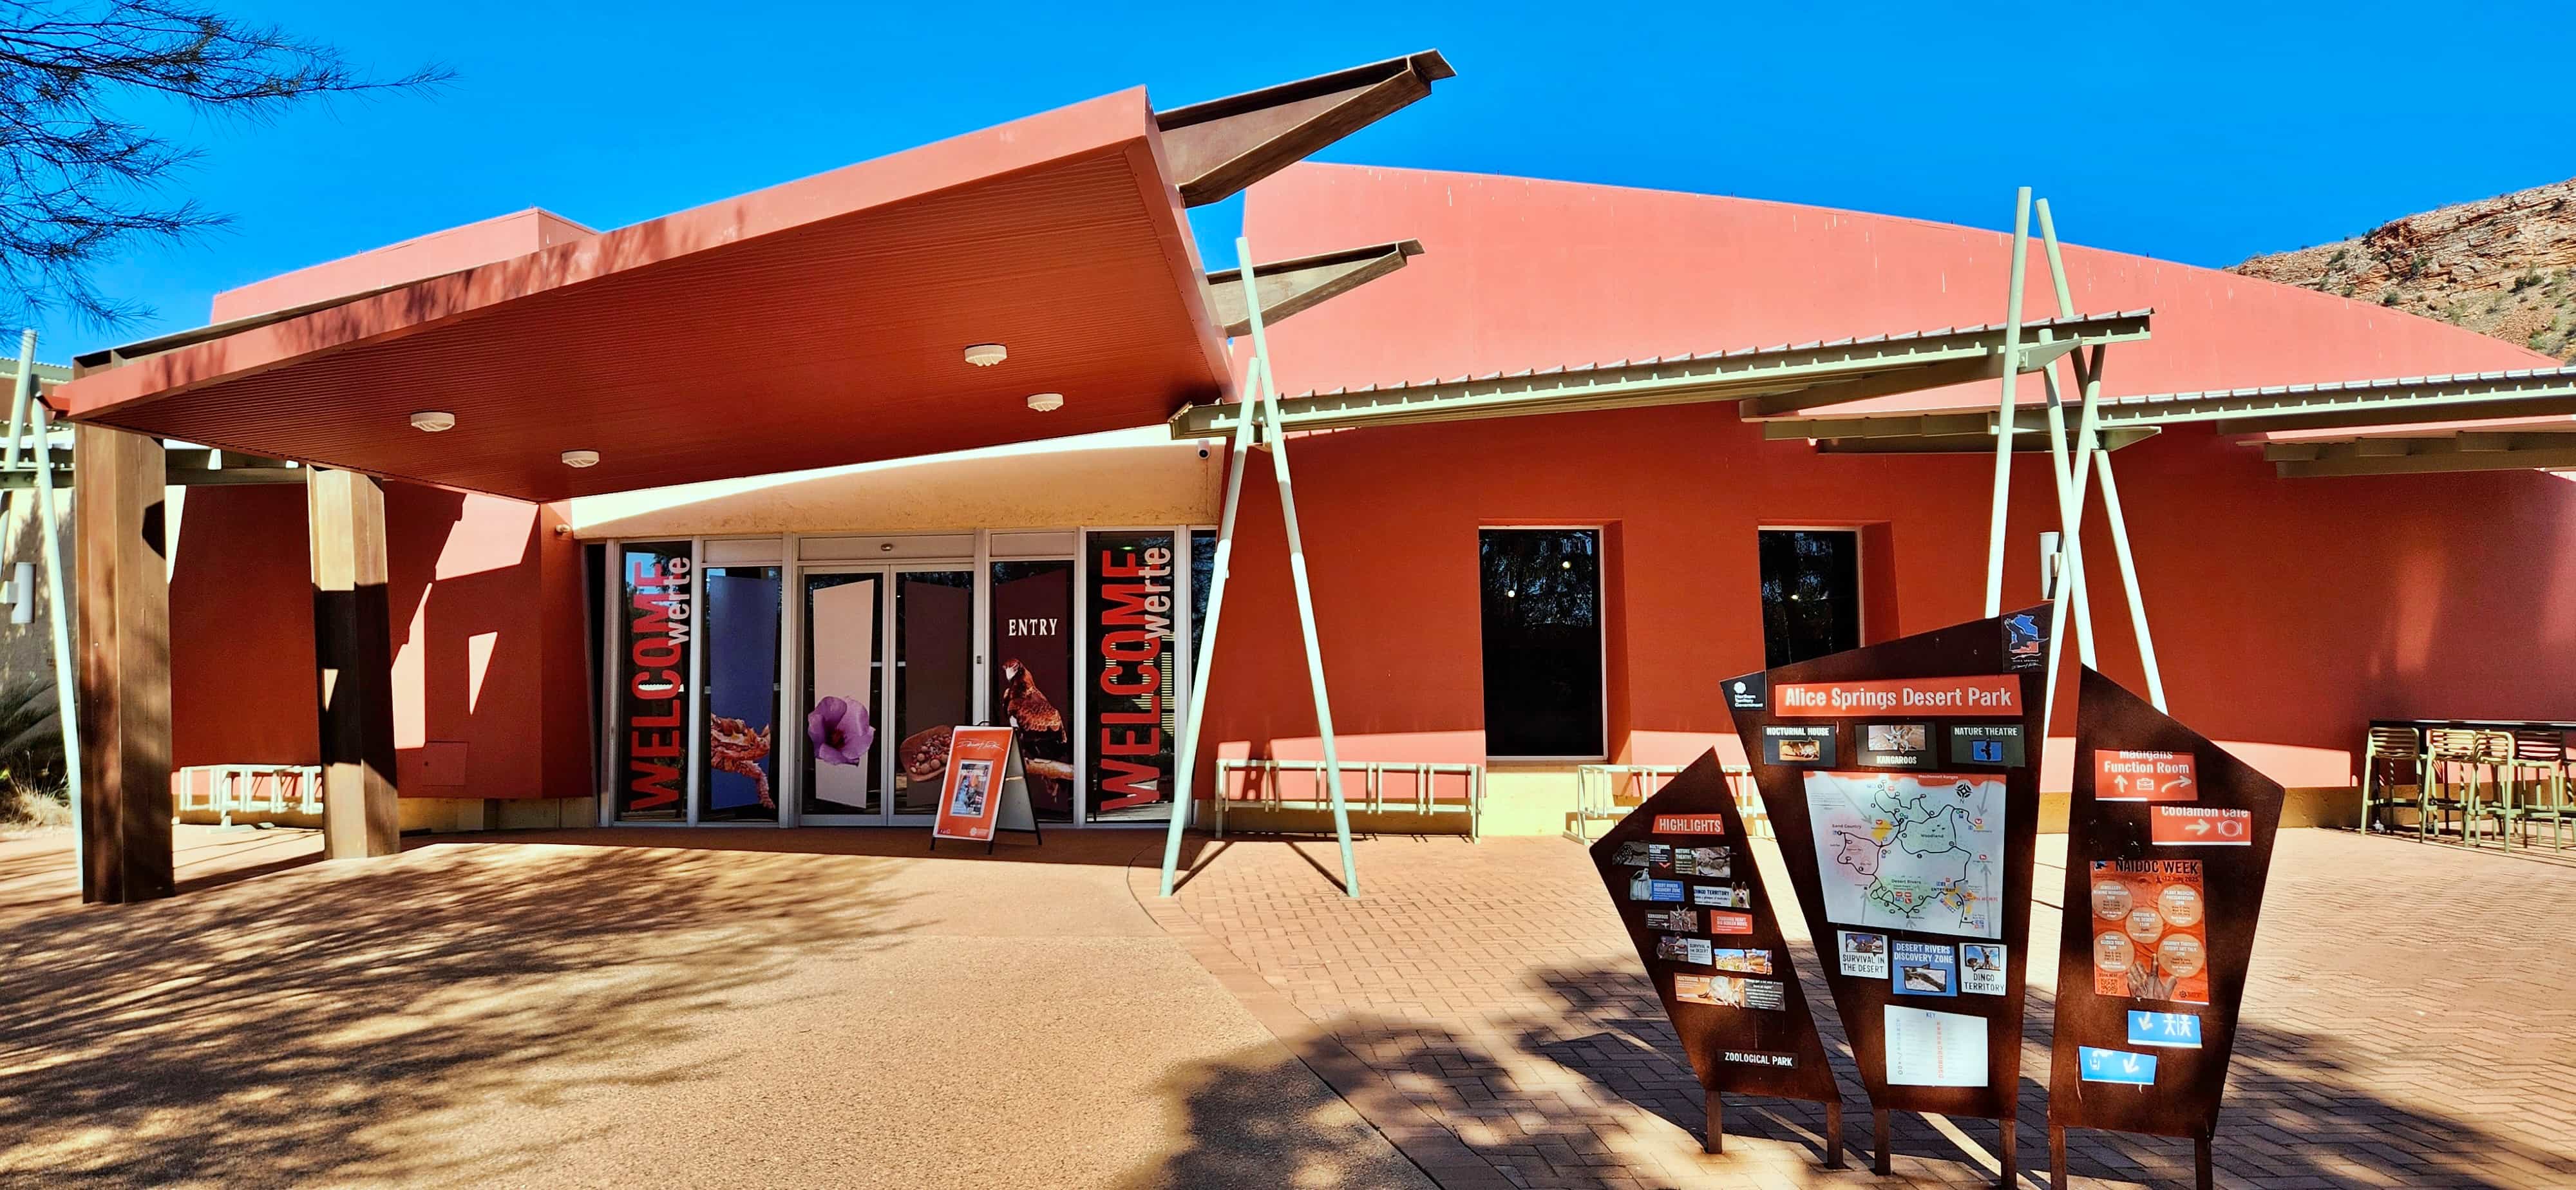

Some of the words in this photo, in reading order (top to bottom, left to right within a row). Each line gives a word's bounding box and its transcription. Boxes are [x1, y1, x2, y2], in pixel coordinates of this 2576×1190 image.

[1138, 547, 1171, 639] werte
[665, 557, 690, 645] werte
[1009, 618, 1057, 636] ENTRY
[630, 562, 681, 810] WELCOME
[1101, 551, 1160, 811] WELCOME
[1786, 688, 1826, 706] Alice
[1832, 687, 1897, 710] Springs
[1903, 687, 1962, 706] Desert
[1968, 686, 2012, 706] Park
[1766, 727, 1806, 736] NOCTURNAL
[1808, 727, 1830, 736] HOUSE
[1955, 727, 1983, 735] NATURE
[1985, 727, 2018, 736] THEATRE
[1877, 755, 1917, 764] KANGAROOS
[2104, 761, 2154, 773] Function
[2157, 761, 2189, 773] Room
[1659, 818, 1721, 832] HIGHLIGHTS
[2115, 860, 2159, 873] NAIDOC
[2163, 861, 2198, 874] WEEK
[1895, 943, 1924, 952] DESERT
[1924, 945, 1951, 954] RIVERS
[1842, 954, 1875, 964] SURVIVAL
[1893, 952, 1932, 963] DISCOVERY
[1935, 954, 1953, 964] ZONE
[1843, 963, 1857, 972] THE
[1858, 964, 1884, 974] DESERT
[1973, 973, 1994, 982] DINGO
[1964, 981, 2004, 992] TERRITORY
[1725, 1052, 1770, 1064] ZOOLOGICAL
[1772, 1055, 1793, 1067] PARK
